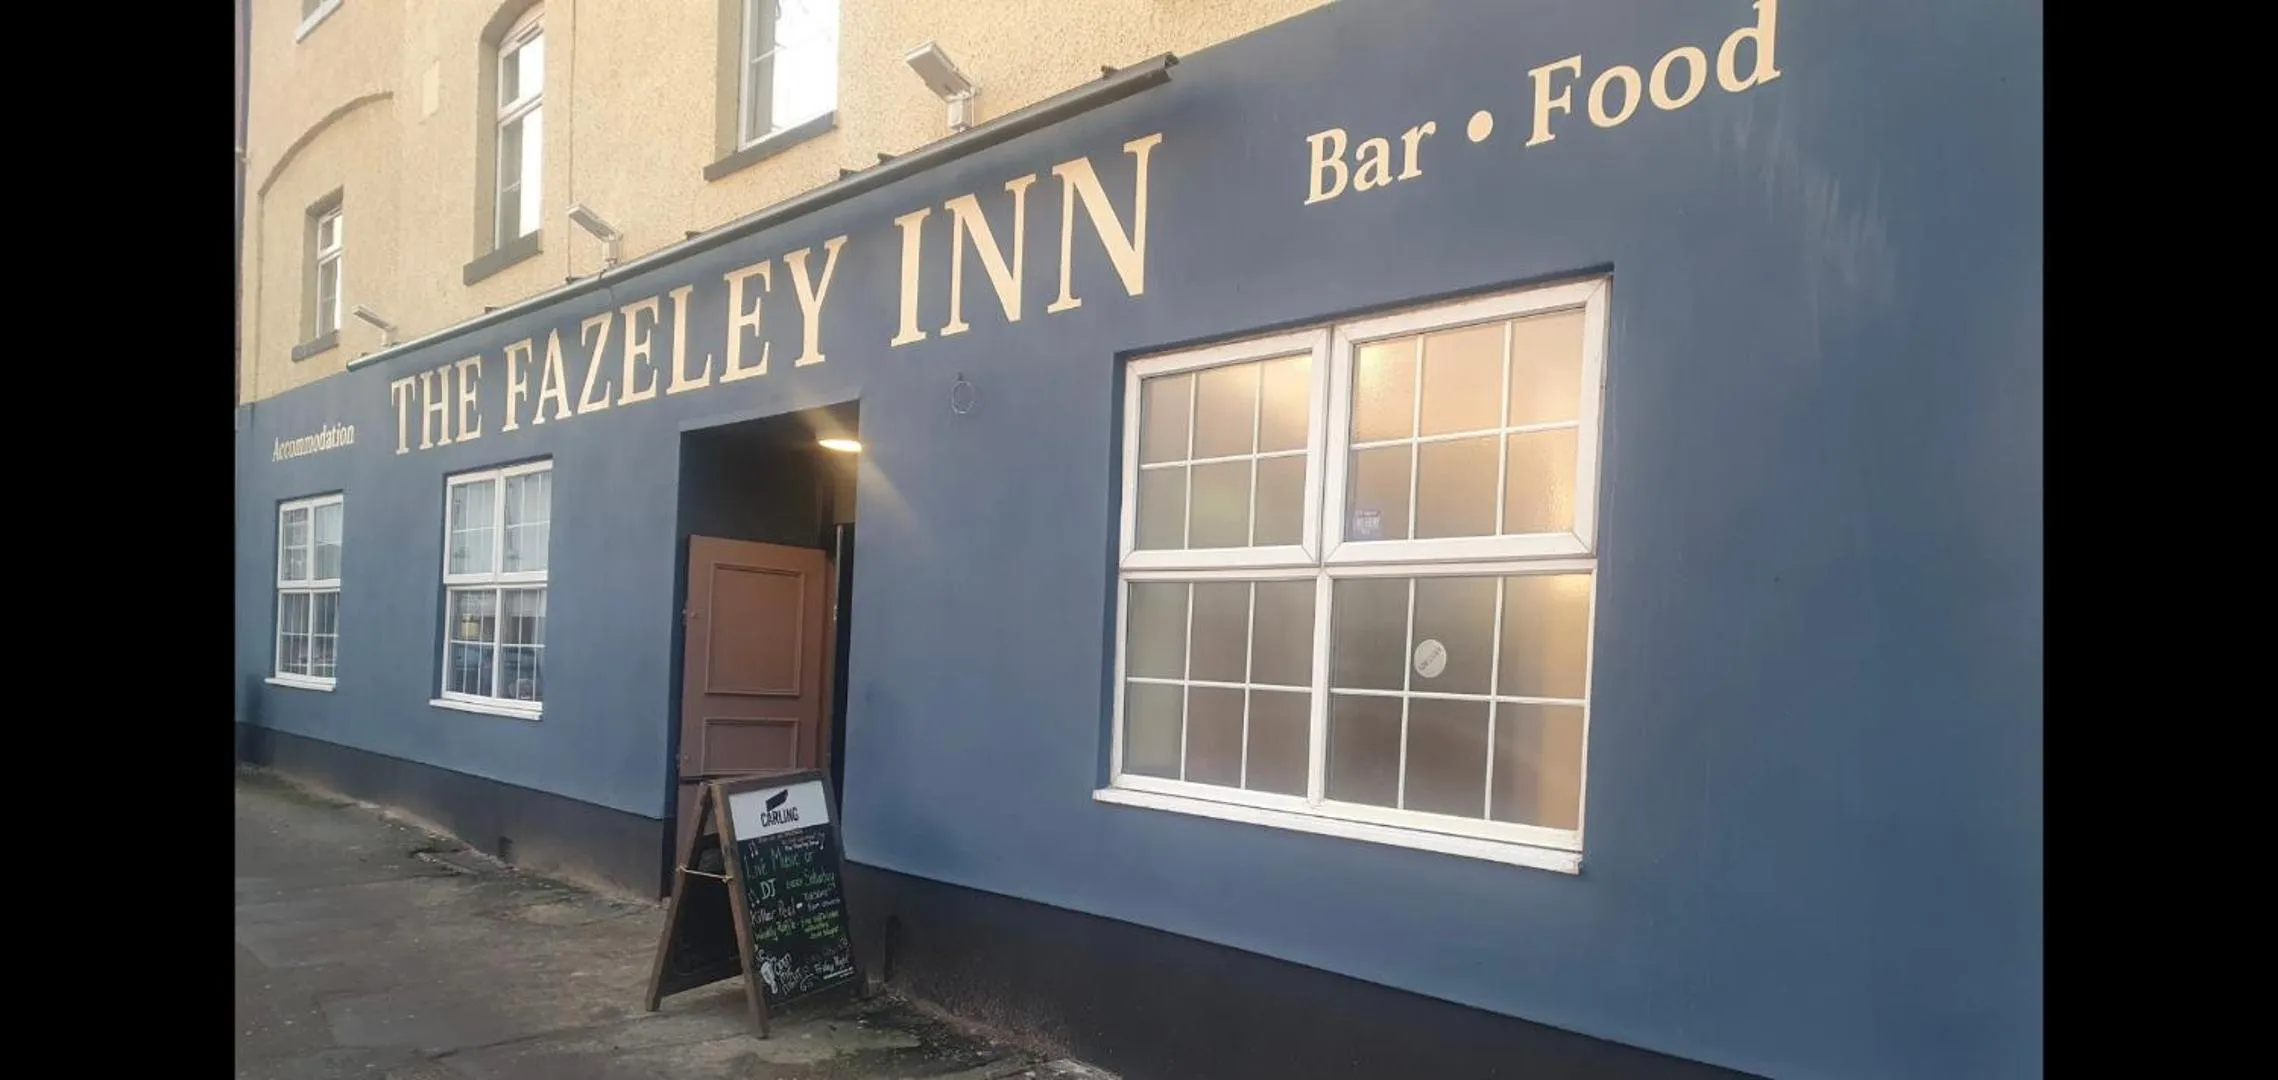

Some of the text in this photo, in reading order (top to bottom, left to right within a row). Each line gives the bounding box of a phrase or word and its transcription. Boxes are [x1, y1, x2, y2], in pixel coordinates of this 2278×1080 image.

[1304, 0, 1782, 206] Bar Food
[391, 133, 1163, 456] THE FAZELEY INN
[272, 421, 355, 463] Accommodation
[760, 807, 799, 827] CARLING
[759, 878, 777, 901] DJ
